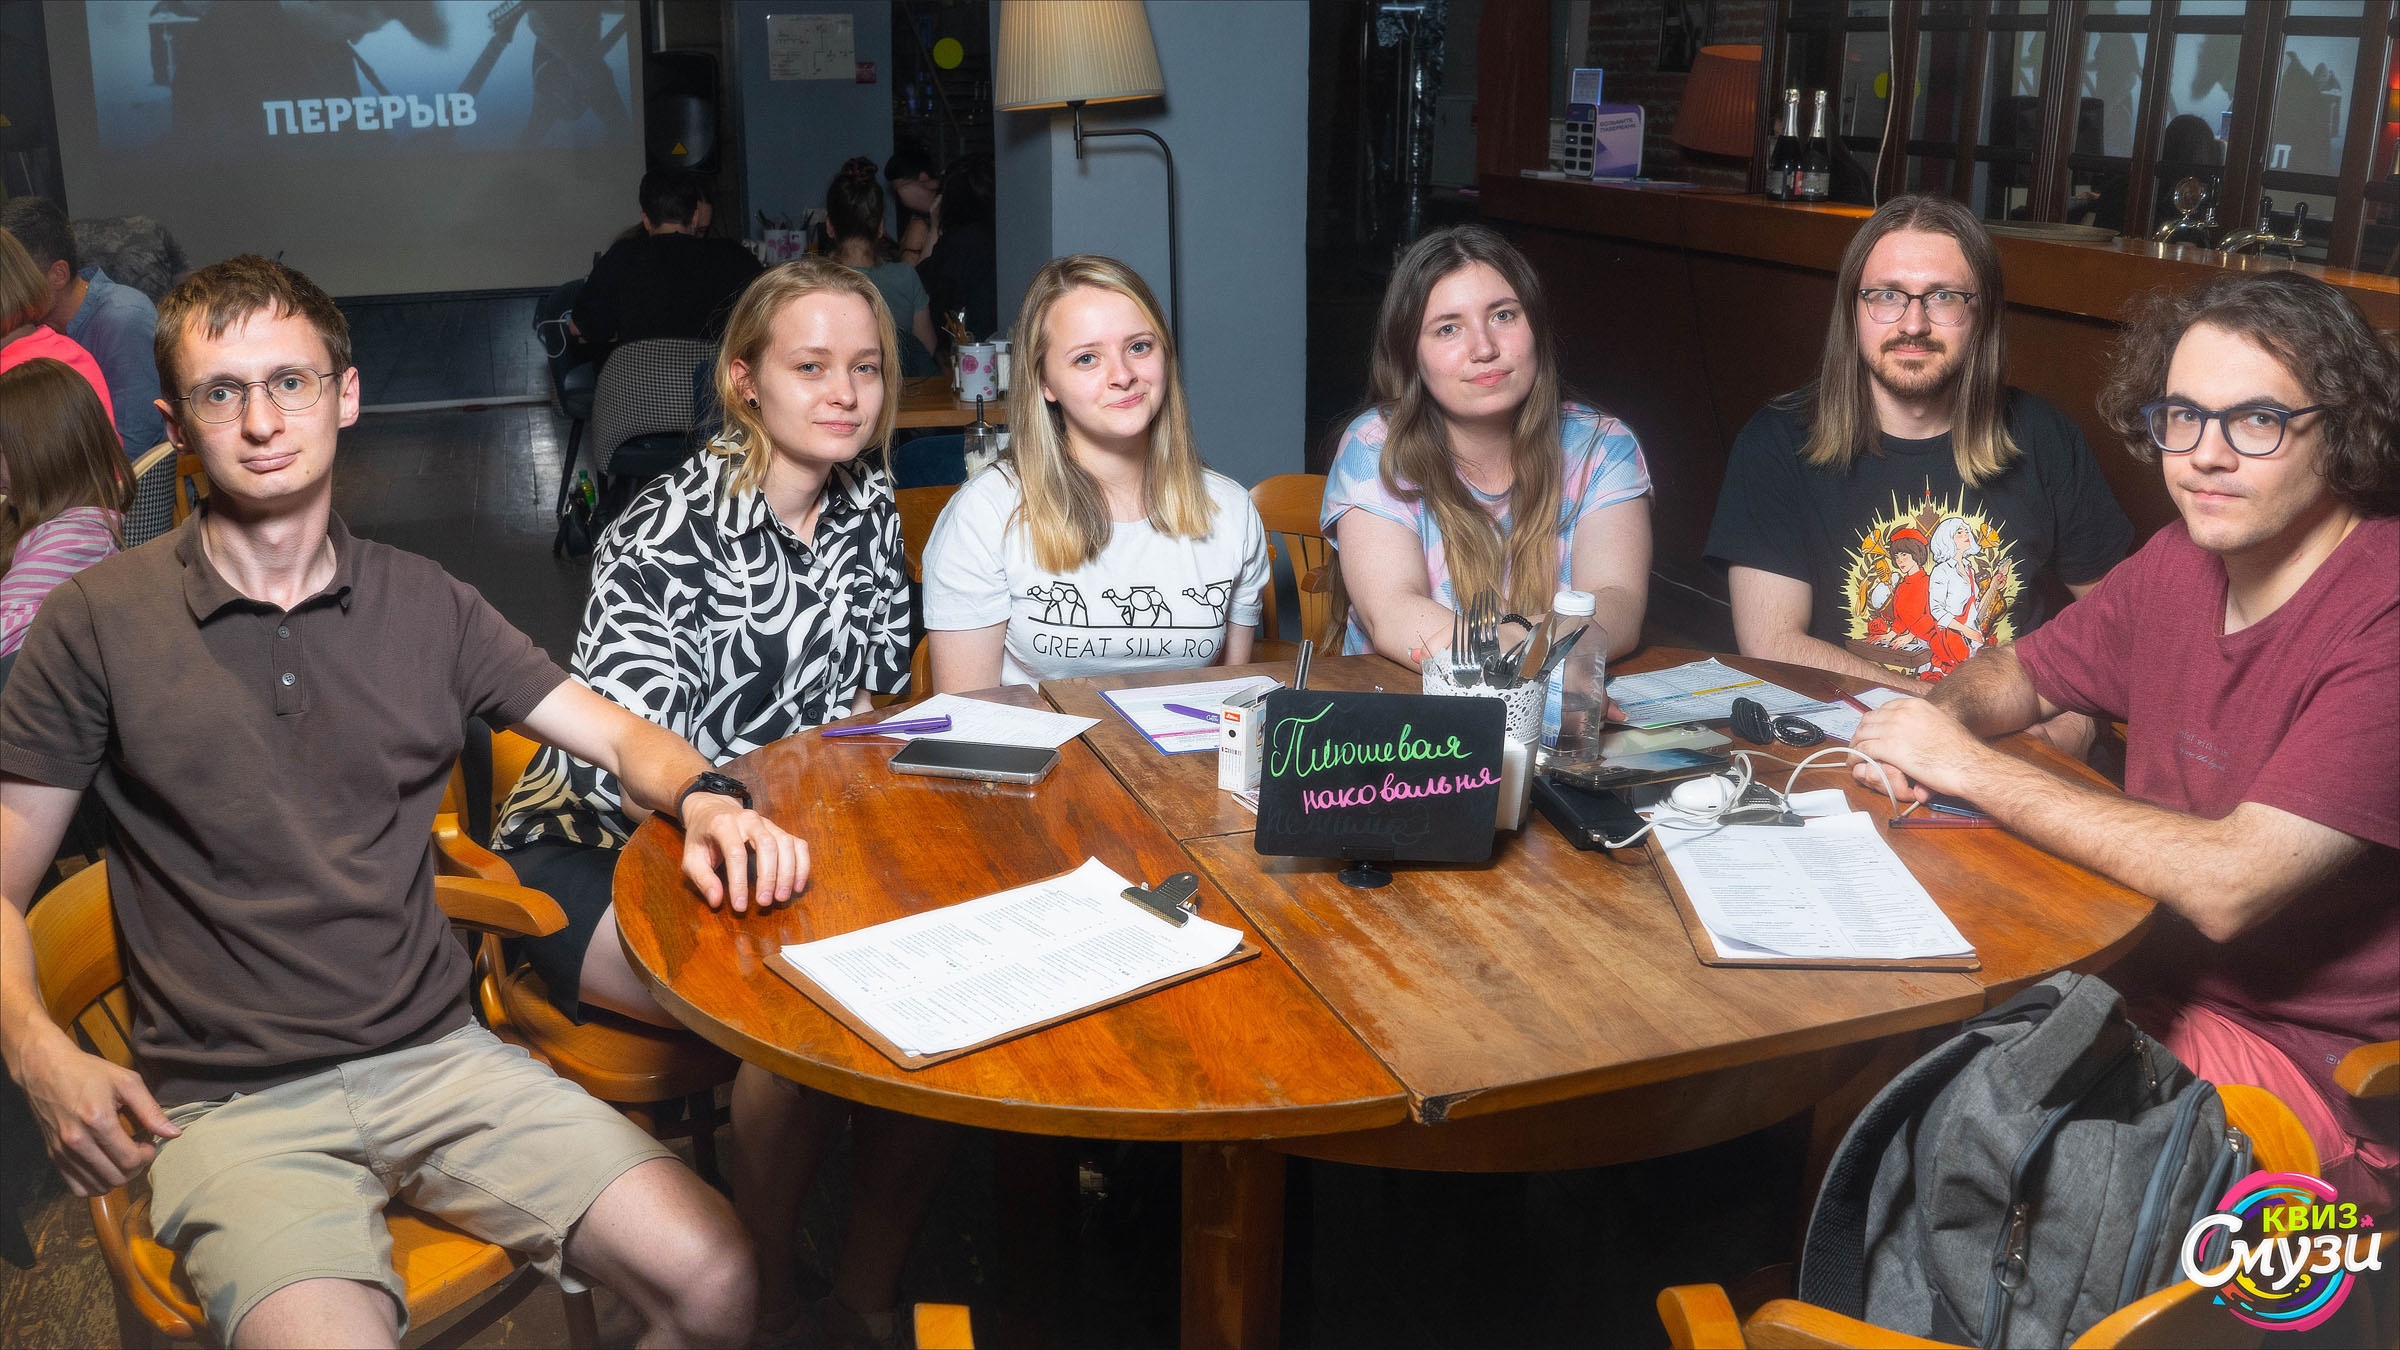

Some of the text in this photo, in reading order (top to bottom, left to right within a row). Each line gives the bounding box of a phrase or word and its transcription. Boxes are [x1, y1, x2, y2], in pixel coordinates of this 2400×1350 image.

[262, 92, 477, 136] ПЕРЕРЫВ
[1033, 633, 1112, 658] GREAT
[1124, 637, 1172, 658] SILK
[1270, 702, 1472, 777] Плюшевая
[1303, 767, 1502, 814] наковальня
